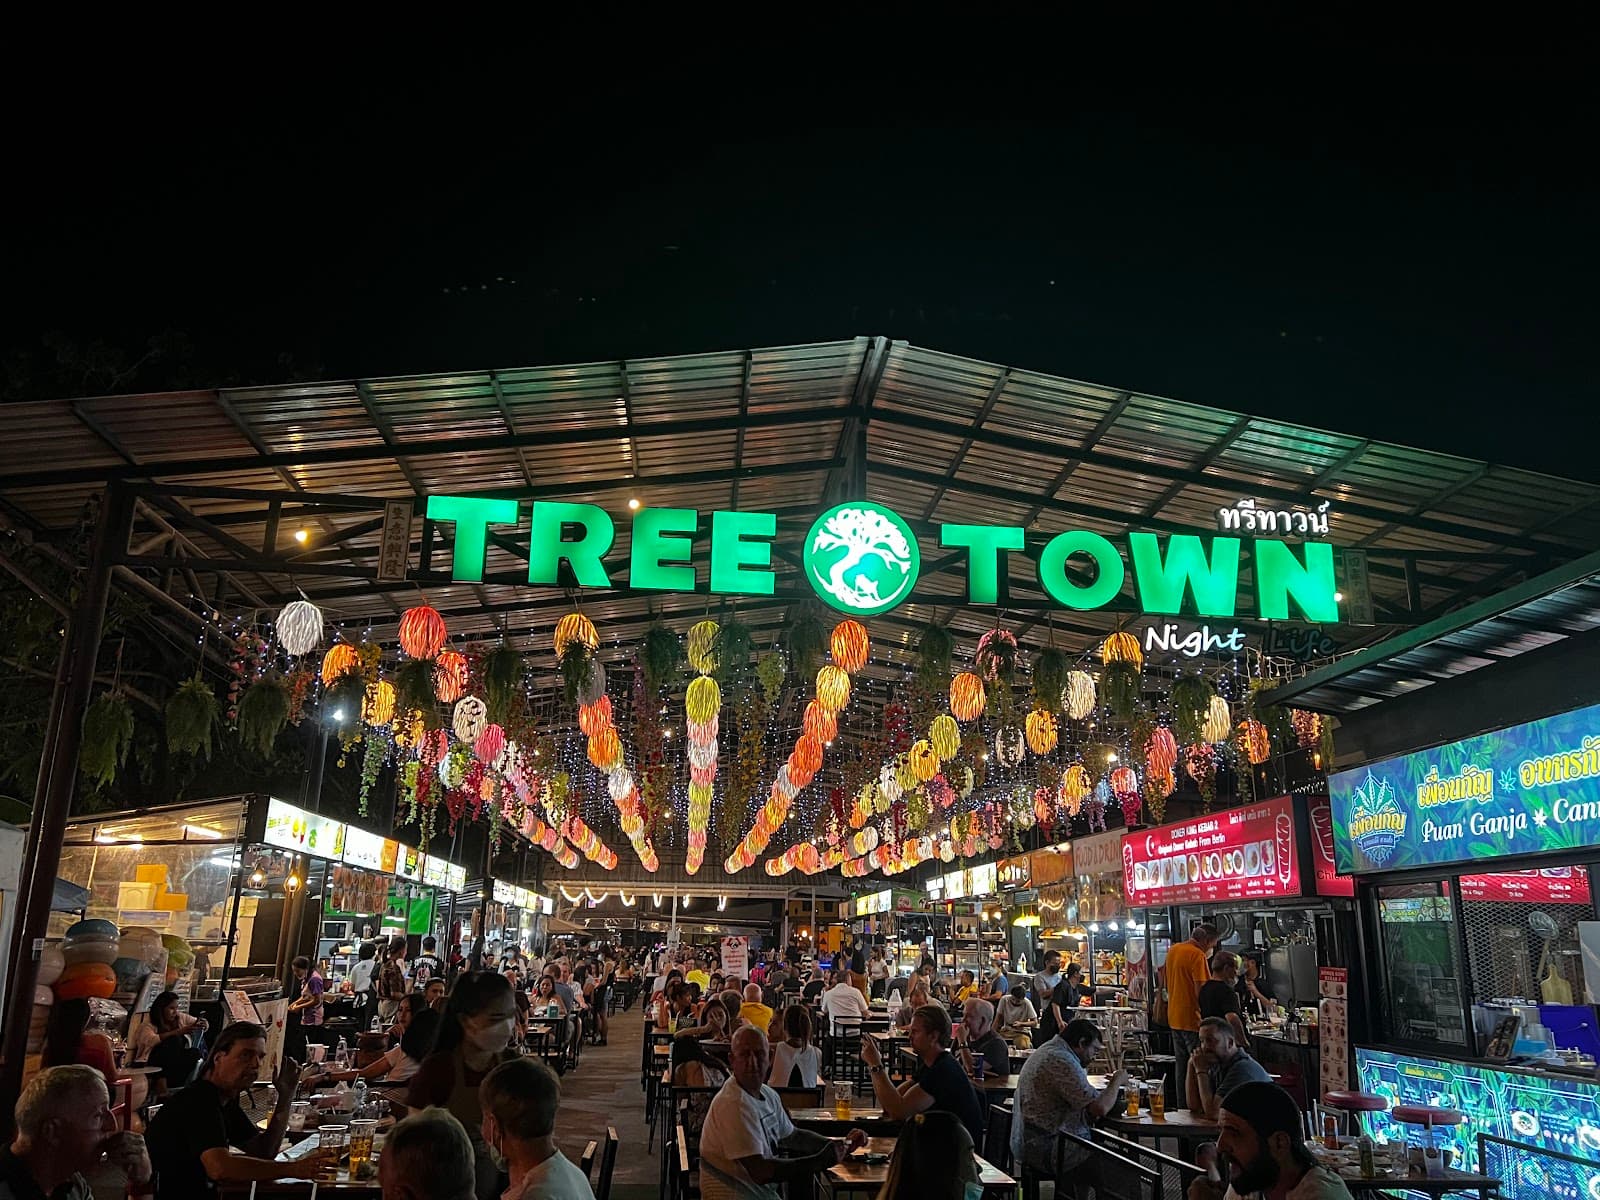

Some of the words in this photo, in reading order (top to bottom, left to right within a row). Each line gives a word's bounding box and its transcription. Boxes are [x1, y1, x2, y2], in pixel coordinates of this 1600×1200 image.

[1220, 499, 1330, 534] ทรีทาวน์
[426, 495, 777, 595] TREE
[941, 523, 1339, 624] TOWN
[1145, 623, 1246, 657] Night
[1269, 627, 1336, 661] Life
[1417, 765, 1494, 809] เพื่อนกัญ
[1198, 820, 1213, 833] KEBAB
[1214, 820, 1218, 830] 2
[1199, 836, 1211, 847] From
[1212, 833, 1225, 844] Berlin
[1470, 808, 1528, 839] Ganja
